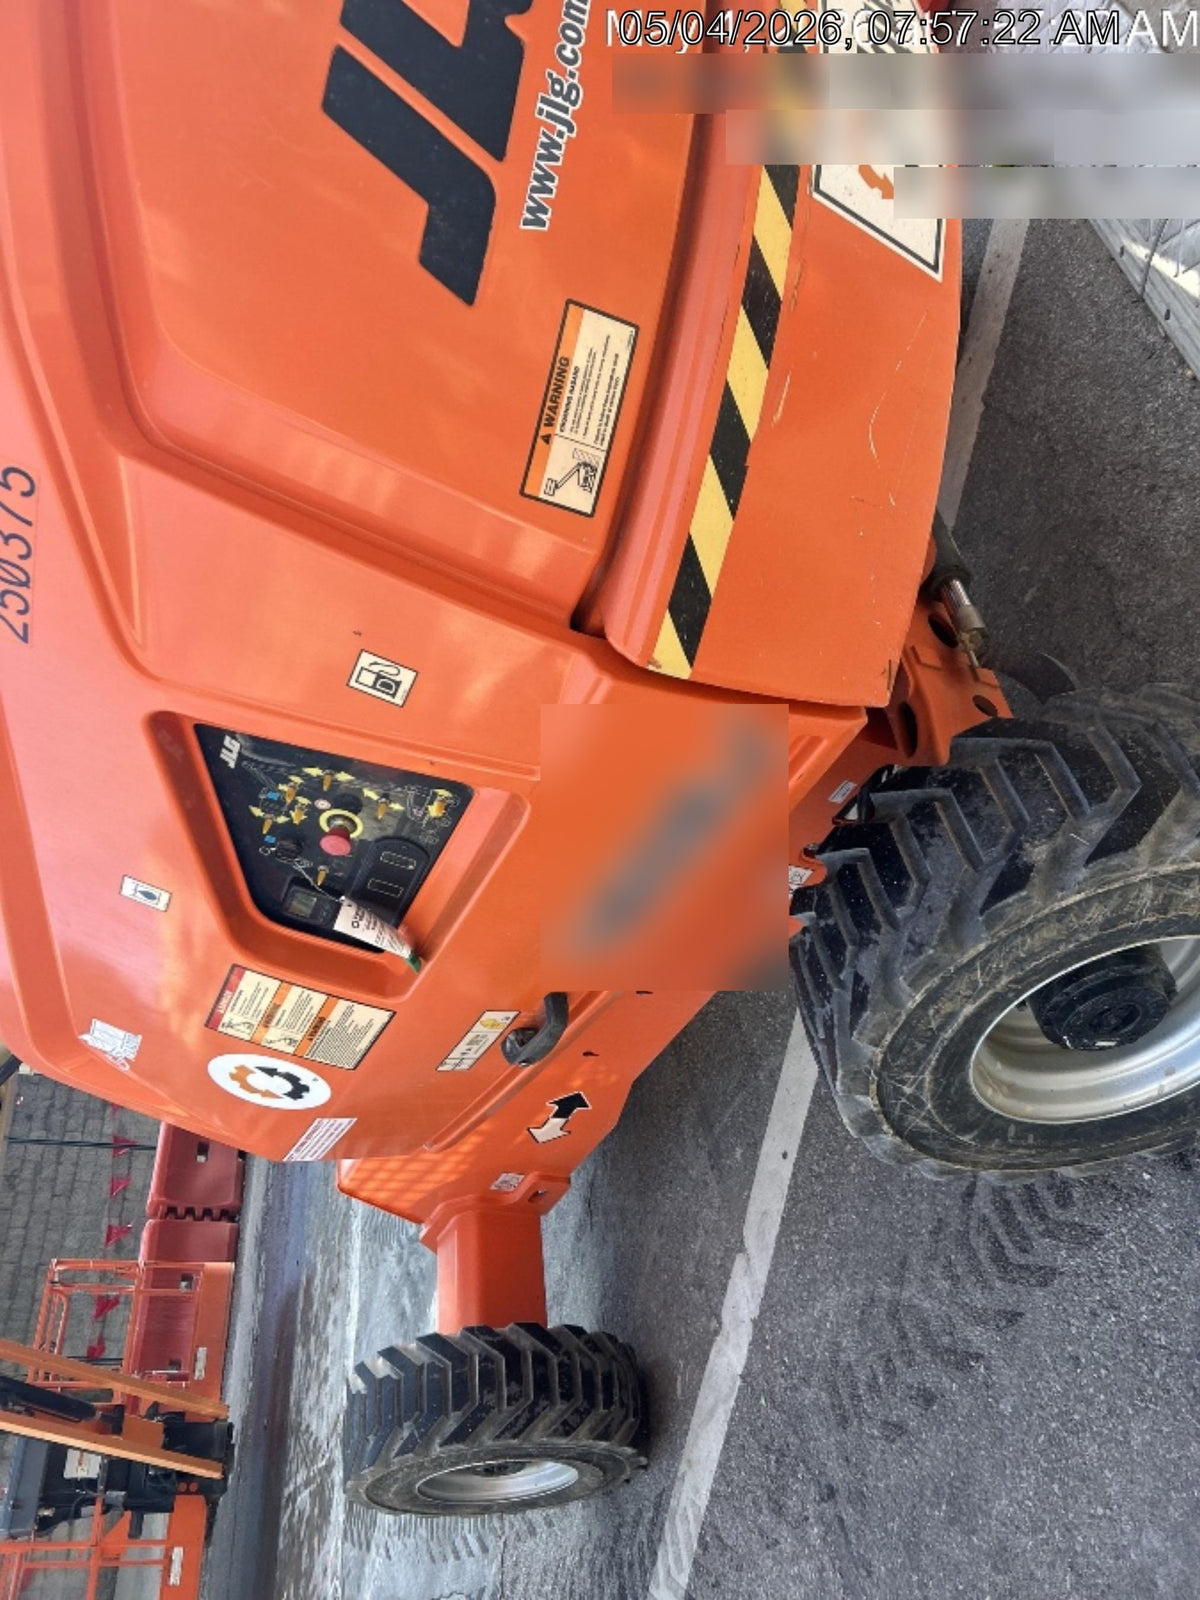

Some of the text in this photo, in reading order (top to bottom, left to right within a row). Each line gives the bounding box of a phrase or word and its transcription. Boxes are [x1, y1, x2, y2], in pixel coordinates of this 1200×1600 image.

[321, 0, 534, 306] JL
[543, 356, 570, 427] WARNING
[219, 734, 241, 769] JLG
